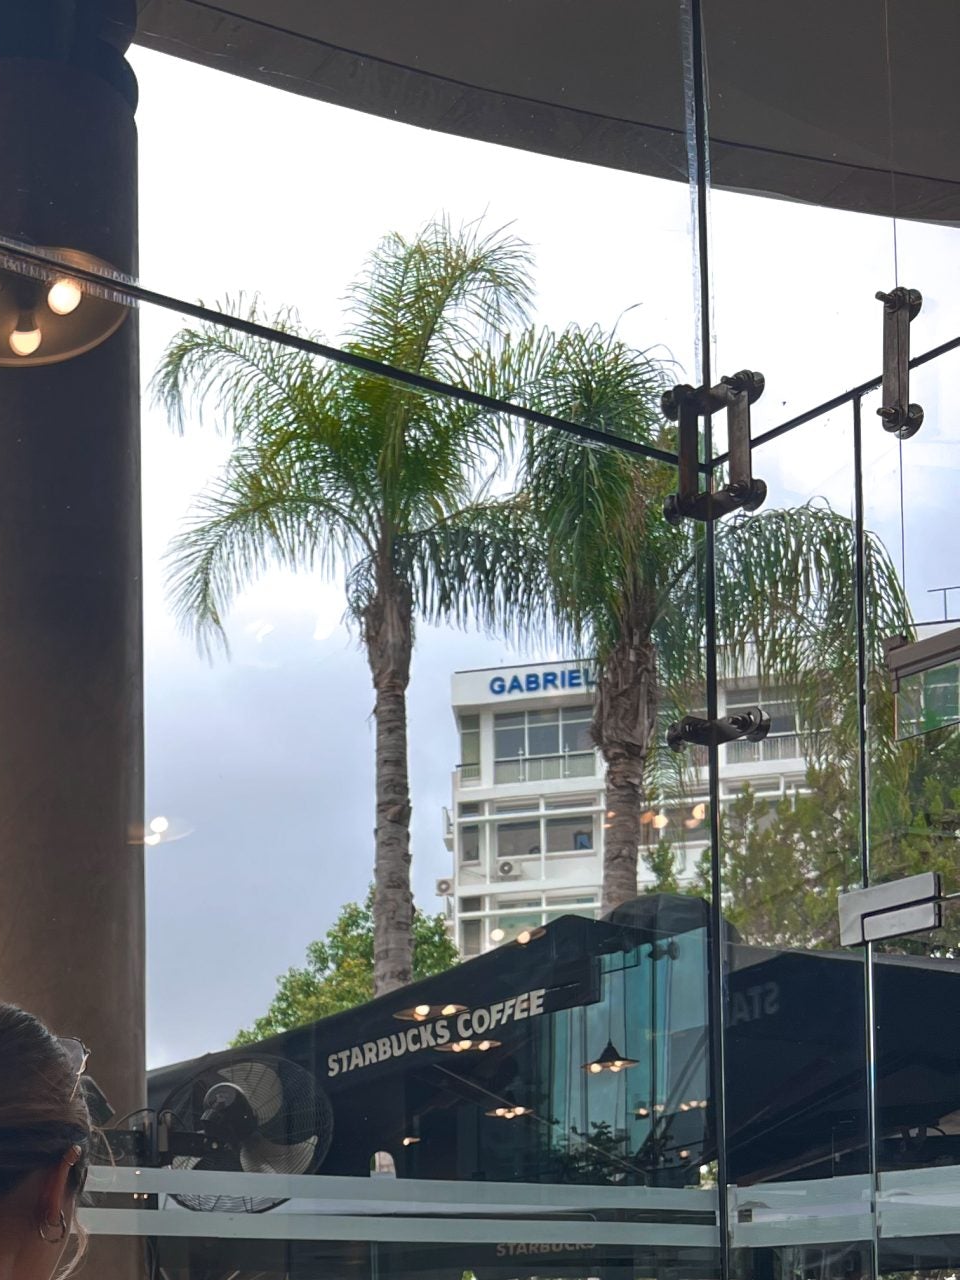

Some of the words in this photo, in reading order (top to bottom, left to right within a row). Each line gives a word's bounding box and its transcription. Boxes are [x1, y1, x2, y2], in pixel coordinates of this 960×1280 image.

[490, 669, 596, 695] GABRIEL
[327, 1021, 451, 1077] STARBUCKS
[456, 988, 546, 1039] COFFEE
